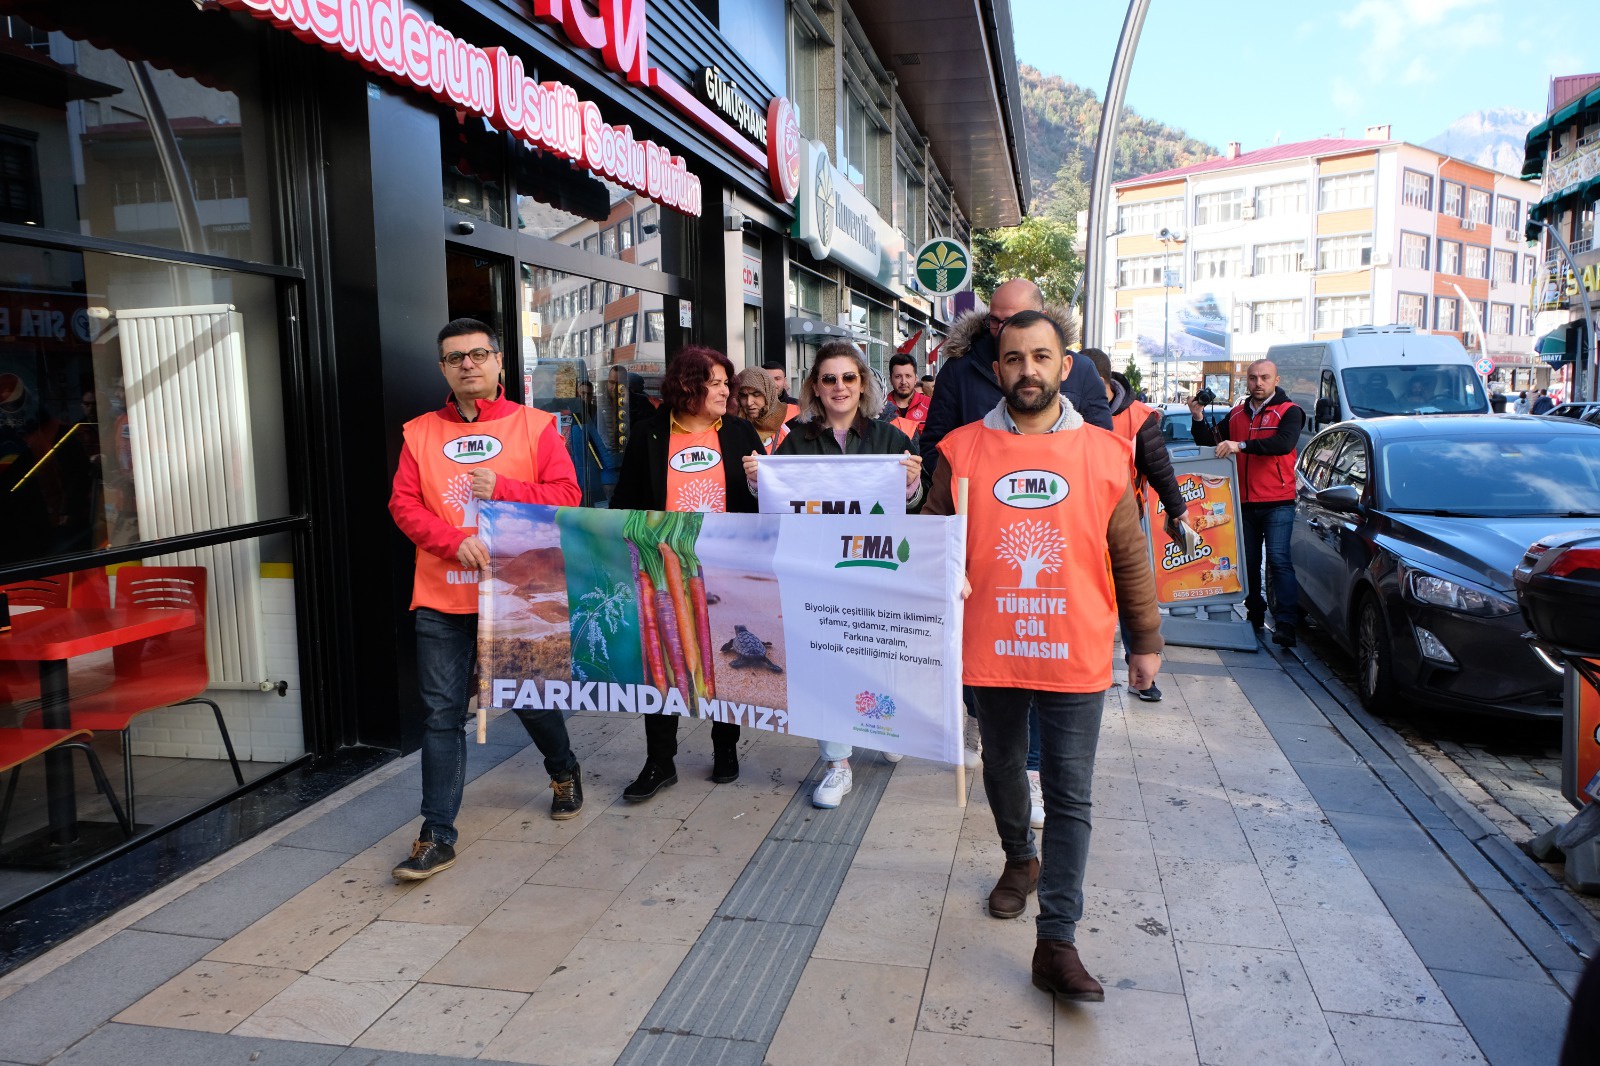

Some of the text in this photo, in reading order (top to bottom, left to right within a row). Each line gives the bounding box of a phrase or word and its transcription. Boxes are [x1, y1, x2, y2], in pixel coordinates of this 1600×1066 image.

[240, 0, 494, 117] enderun
[496, 46, 583, 160] Usulü
[583, 101, 647, 192] Soslu
[646, 140, 702, 218] Dürüm
[705, 65, 767, 145] GÜMÜŞHANE
[457, 440, 484, 453] TEMA
[680, 451, 707, 464] TEMA
[1009, 478, 1047, 494] TEMA
[841, 535, 893, 559] TEMA
[446, 570, 480, 584] OLMA
[805, 602, 944, 626] Biyolojik çeşitlilik bizim iklimimiz,
[996, 593, 1067, 615] TÜRKİYE
[819, 617, 932, 637] şifamız, gıdamız, mirasımız.
[1015, 616, 1046, 638] ÇÖL
[843, 632, 908, 649] Farkına varalım,
[995, 640, 1068, 660] OLMASIN
[810, 641, 943, 667] biyolojik çeşitliliğimizi koruyalım.
[493, 679, 788, 734] FARKINDA MIYIZ?
